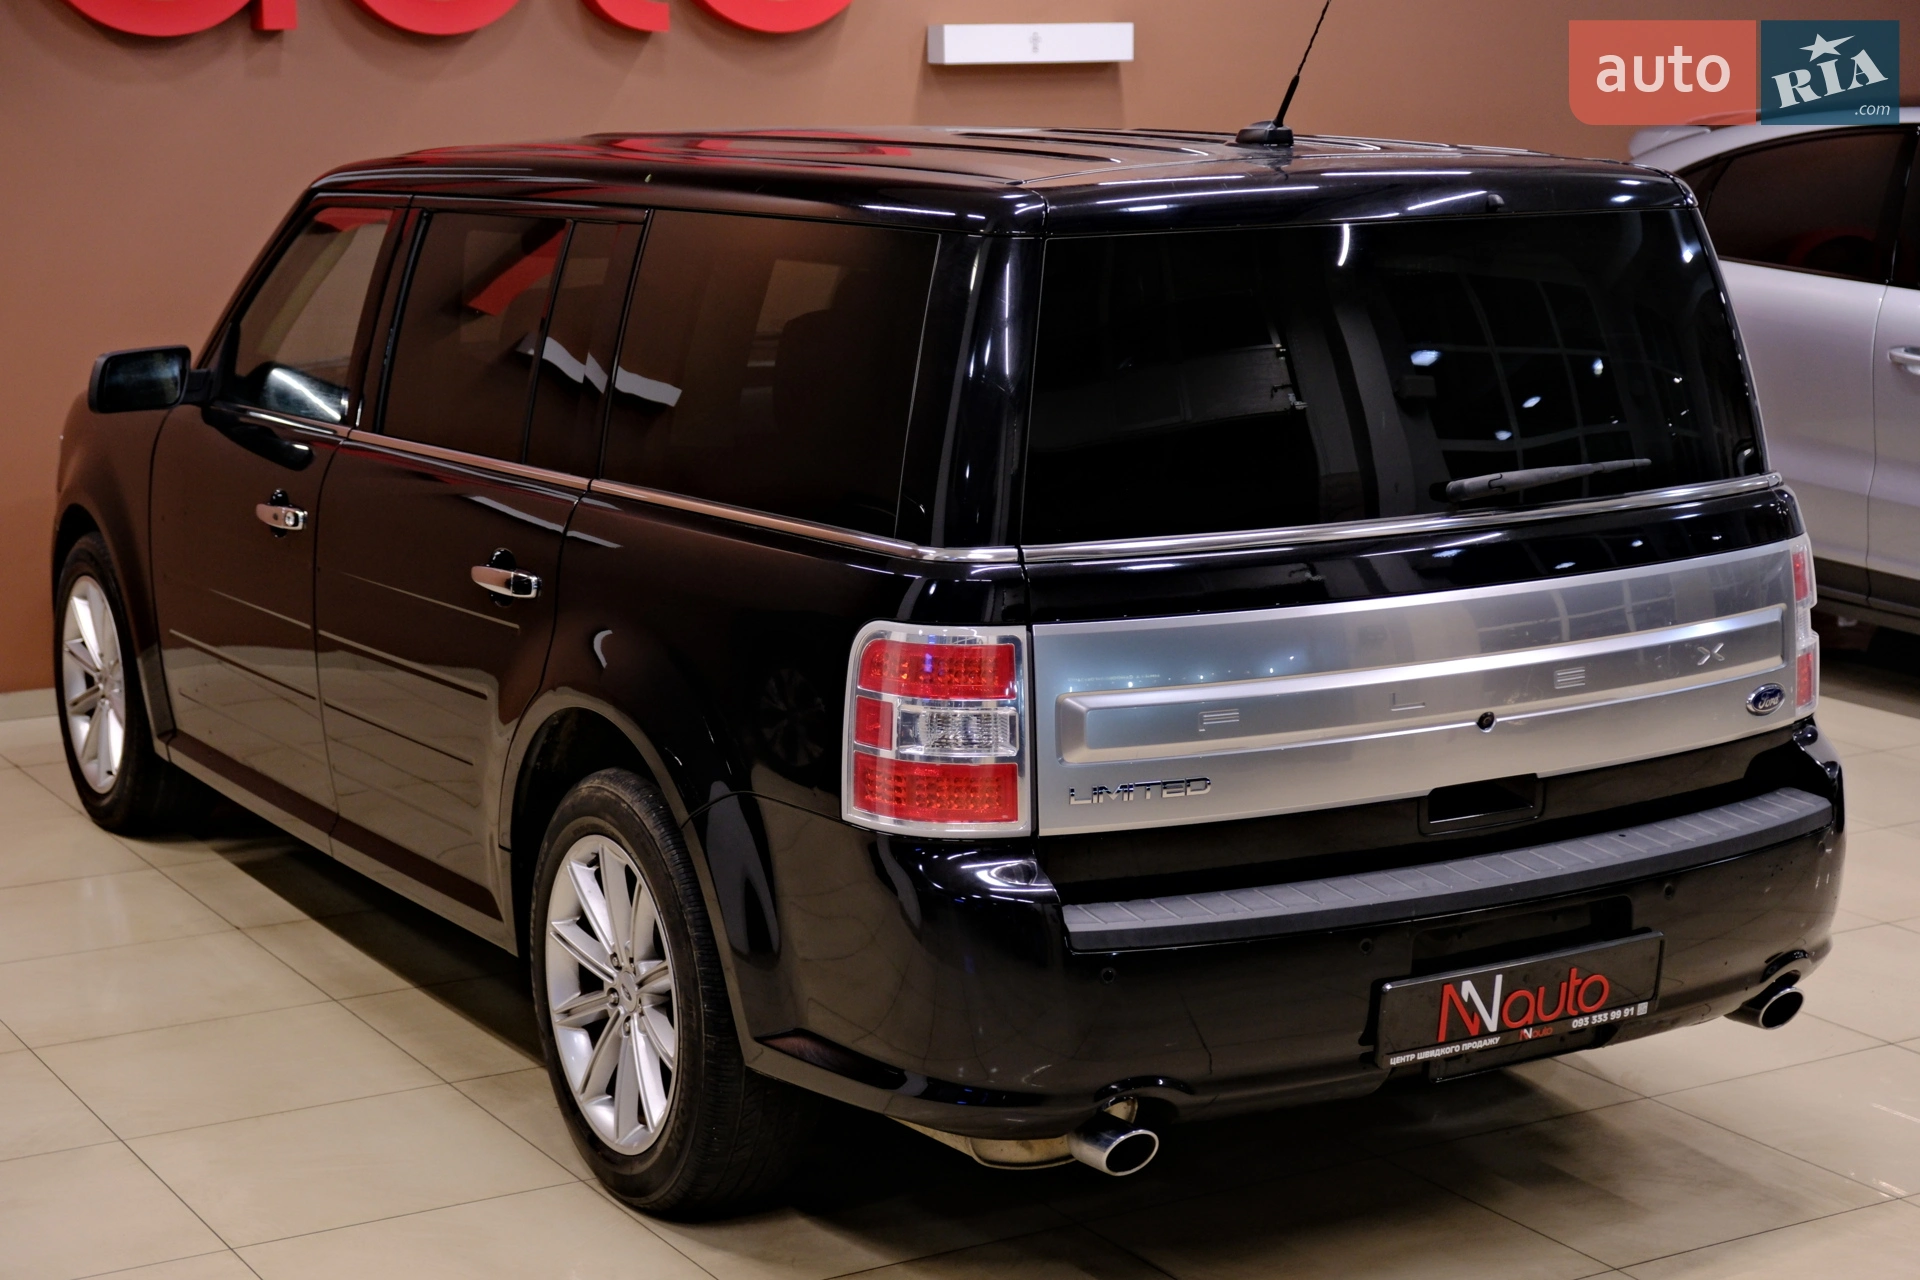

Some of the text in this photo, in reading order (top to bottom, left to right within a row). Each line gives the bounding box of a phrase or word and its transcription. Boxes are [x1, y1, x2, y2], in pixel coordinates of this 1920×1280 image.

[1069, 776, 1212, 805] LIMITED
[1571, 1006, 1635, 1029] 093 333 99 91
[1389, 1036, 1501, 1066] ЦЕНТР ШВИДКОГО ПРОДАЖУ
